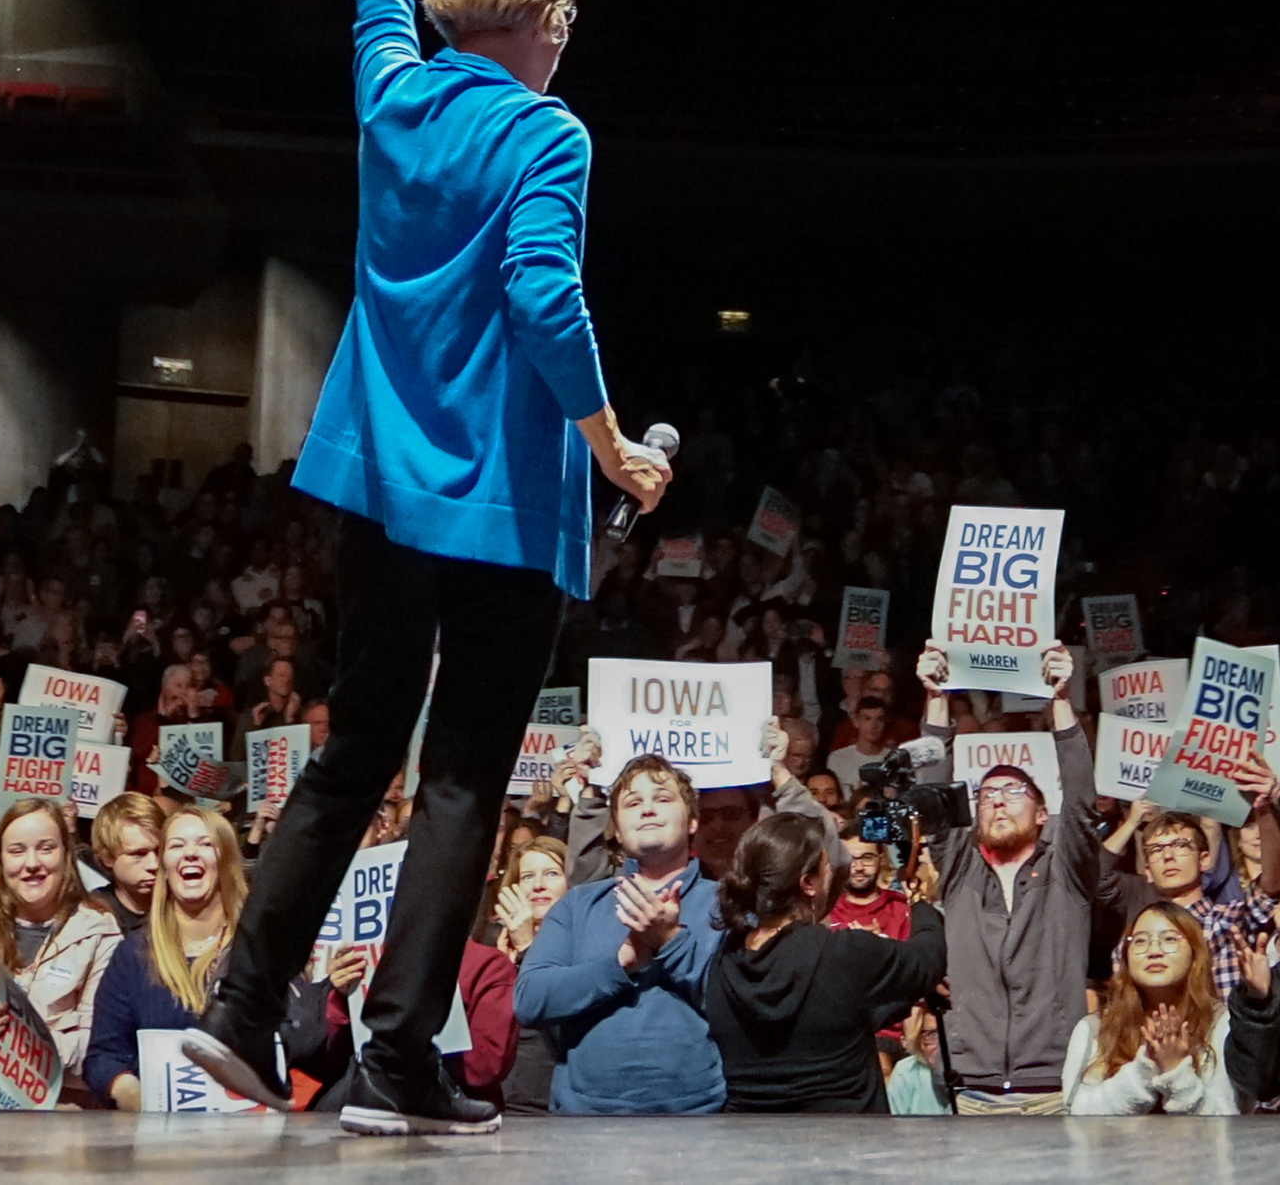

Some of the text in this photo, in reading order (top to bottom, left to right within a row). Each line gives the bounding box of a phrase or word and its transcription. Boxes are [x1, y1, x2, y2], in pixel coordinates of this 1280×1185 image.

[961, 524, 1045, 551] DREAM
[954, 551, 1039, 589] BIG
[949, 589, 1038, 624] FIGHT
[948, 624, 1038, 647] HARD
[970, 654, 1018, 668] WARREN
[1113, 671, 1163, 700] IOWA
[1203, 657, 1265, 696] DREAM
[43, 677, 100, 706] IOWA
[632, 678, 728, 717] IOWA
[539, 709, 573, 725] BIG
[1194, 684, 1261, 731] BIG
[12, 716, 69, 736] DREAM
[10, 734, 67, 760] BIG
[524, 734, 556, 754] WA
[630, 730, 730, 758] WARREN
[1123, 729, 1170, 756] IOW
[1183, 719, 1259, 762] FIGHT
[75, 753, 102, 776] WA
[172, 748, 201, 786] BIG
[279, 737, 288, 798] HARD
[292, 751, 300, 779] ARREN
[968, 744, 1033, 768] IOWA
[6, 759, 65, 782] FIGHT
[514, 763, 554, 778] ARREN
[1121, 763, 1154, 784] WAR
[3, 780, 64, 796] HARD
[73, 782, 99, 802] REN
[1184, 778, 1226, 798] WARREN
[355, 864, 394, 898] DRE
